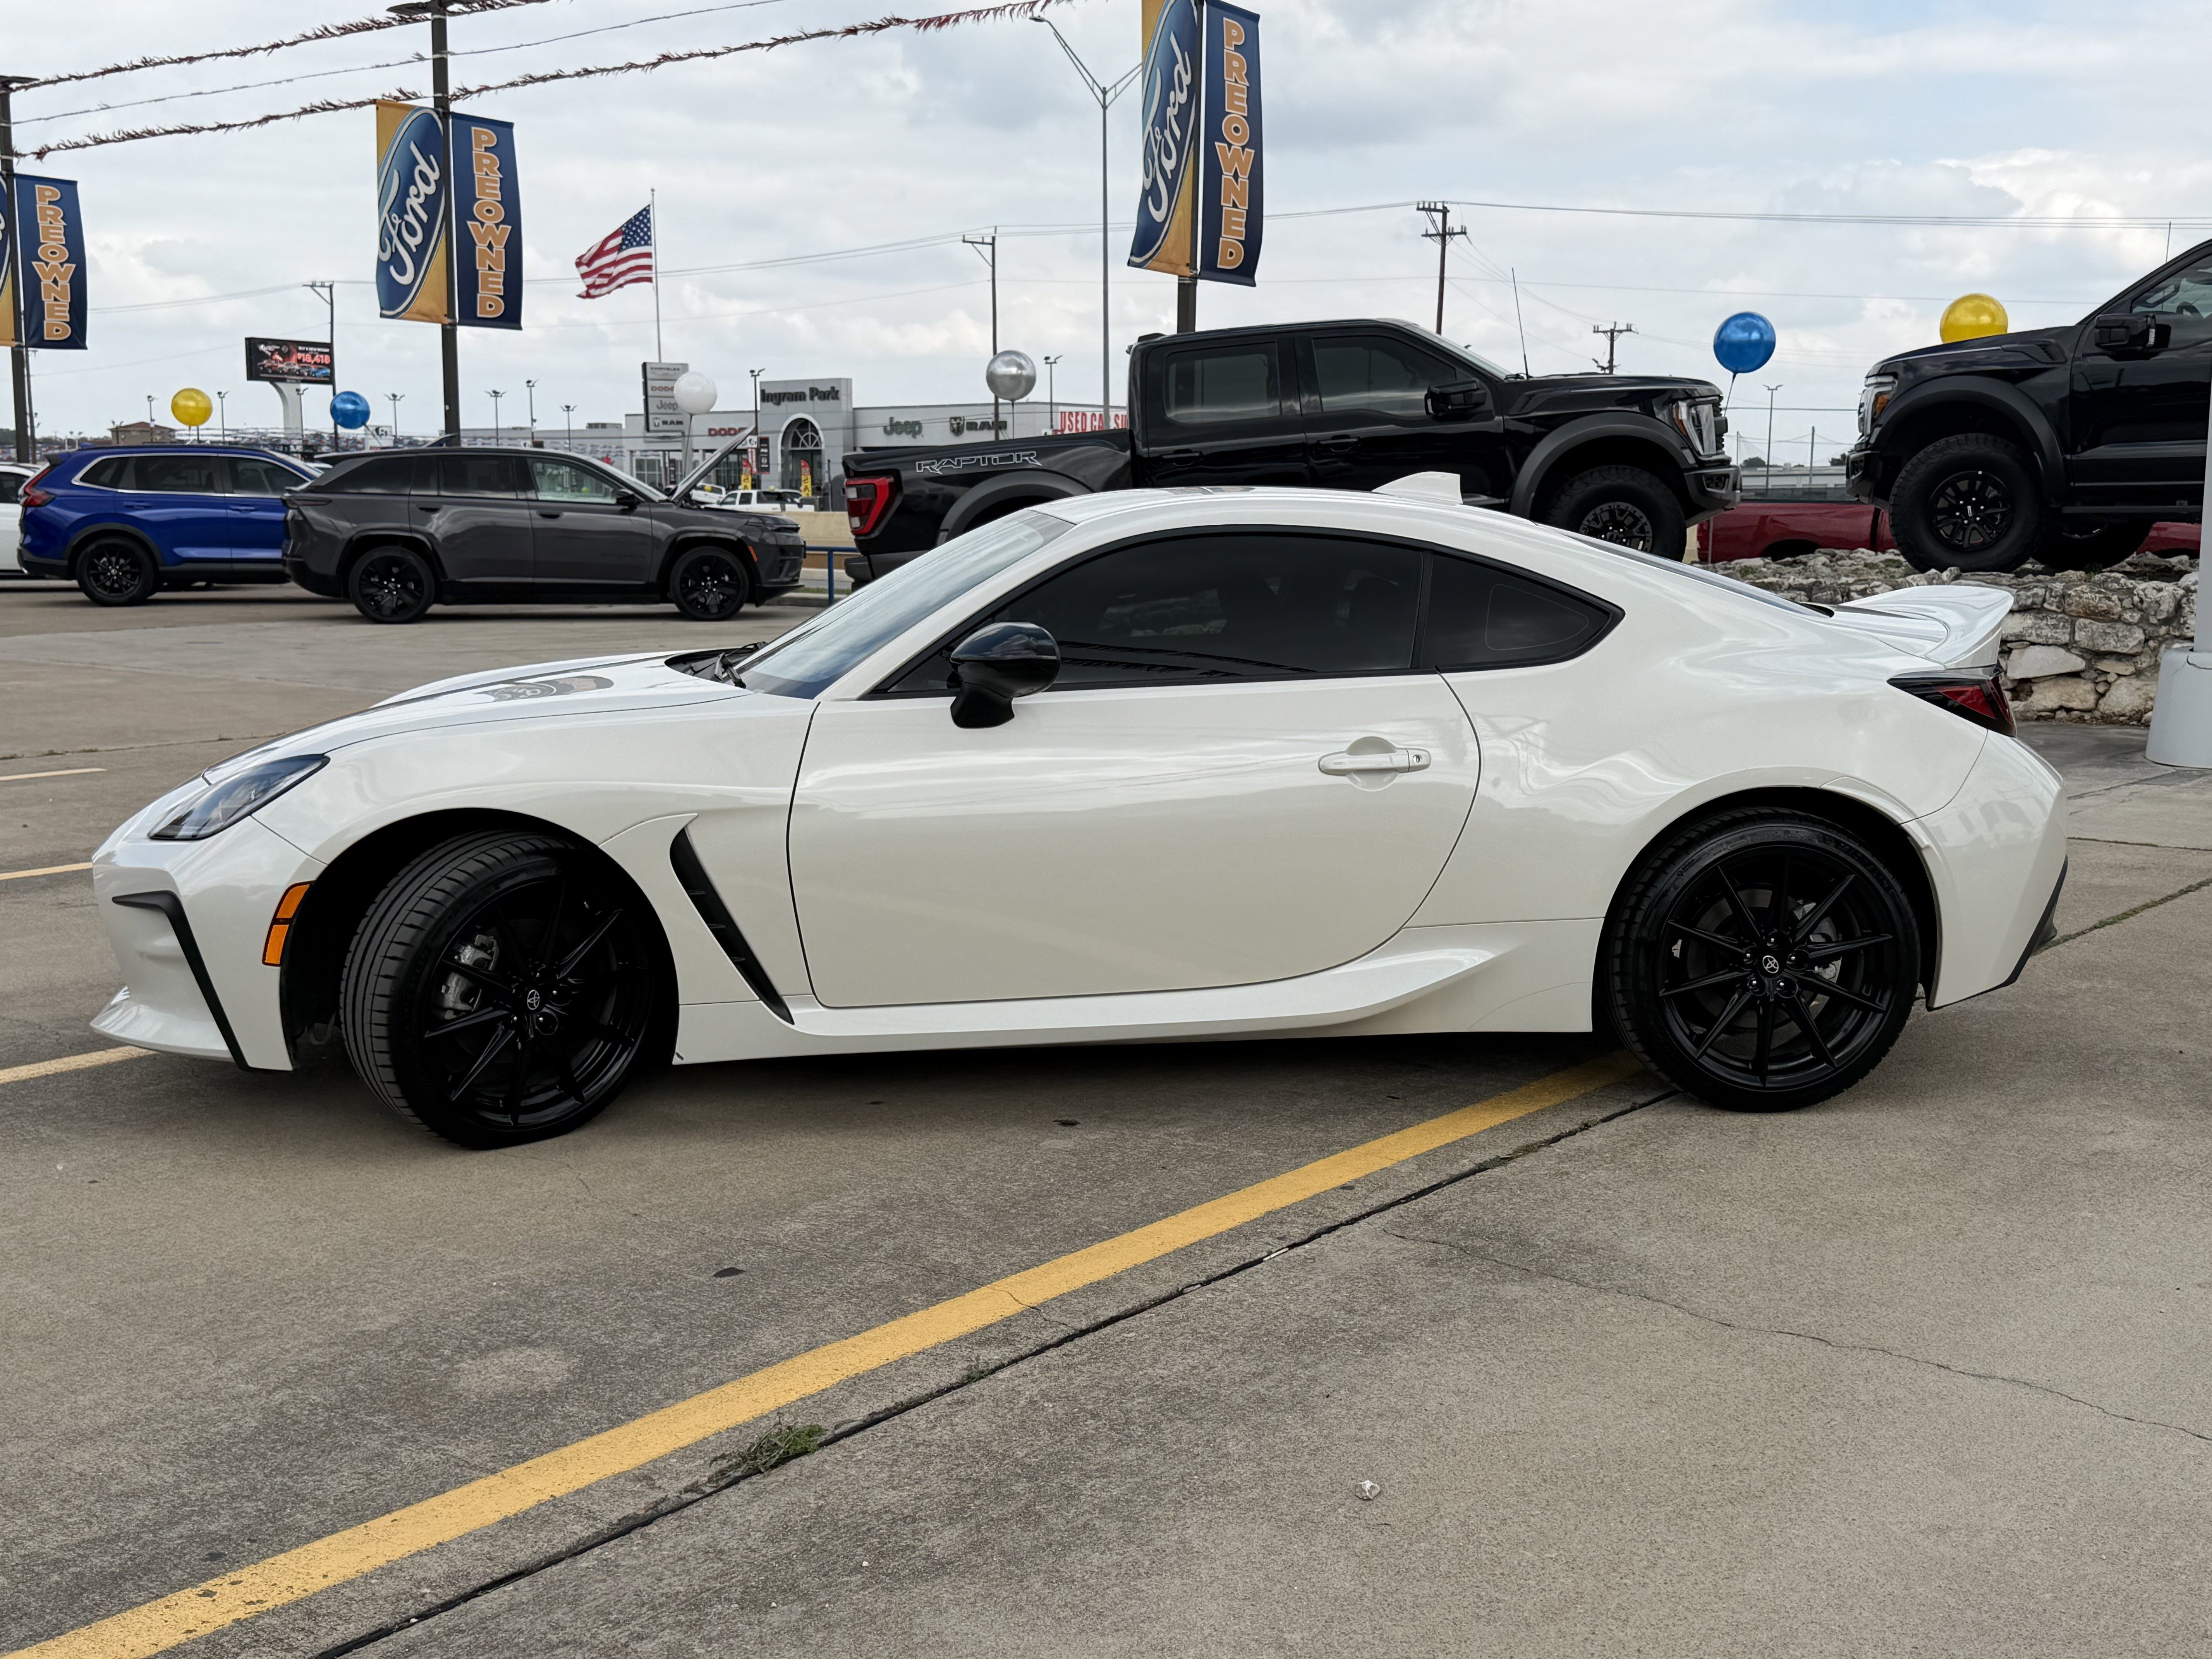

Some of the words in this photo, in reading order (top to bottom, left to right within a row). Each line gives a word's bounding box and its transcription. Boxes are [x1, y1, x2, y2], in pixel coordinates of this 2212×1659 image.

[1143, 31, 1191, 222] Ford
[1215, 17, 1255, 270] PREOWNED
[379, 141, 440, 285] Ford
[467, 126, 512, 318] PREOWNED
[31, 184, 76, 341] PREOWNED
[708, 427, 749, 436] DOD
[760, 389, 806, 405] Ingram
[809, 386, 840, 401] Park
[884, 417, 923, 439] Jeep
[1060, 411, 1087, 433] USED
[1091, 413, 1104, 431] CA
[916, 451, 1042, 474] RAPTOR
